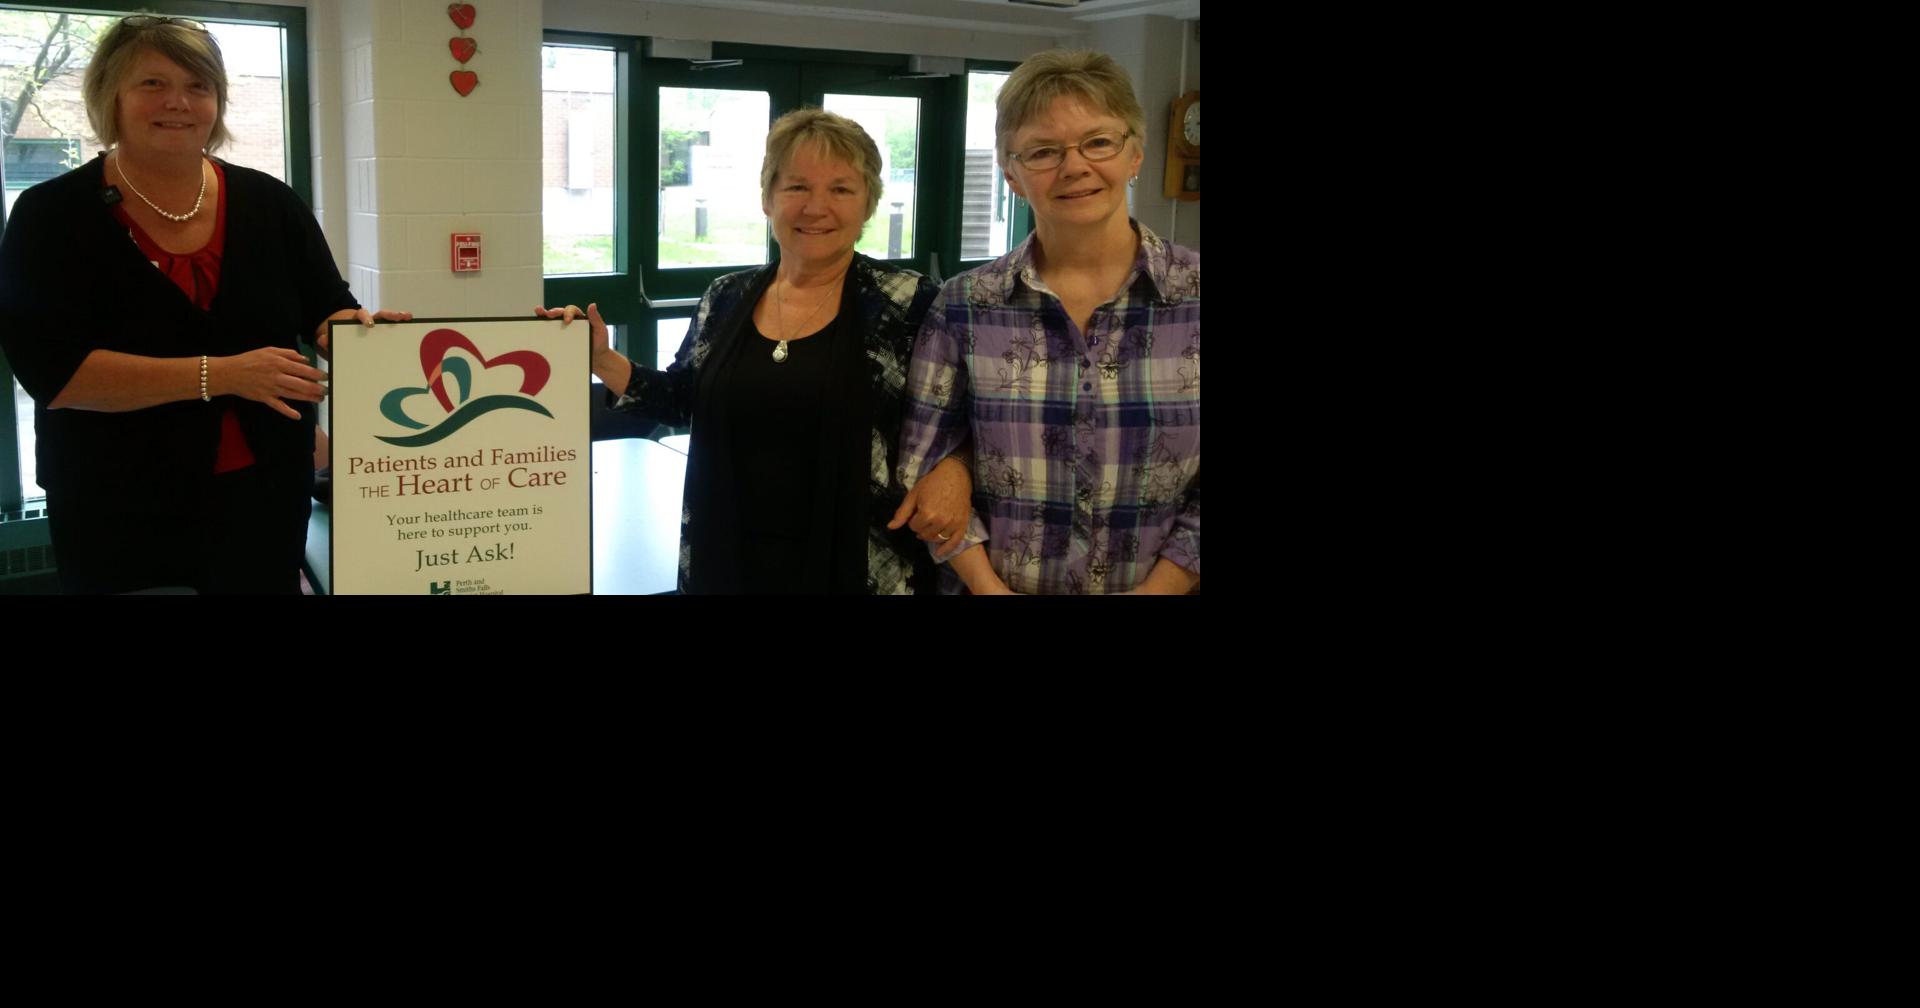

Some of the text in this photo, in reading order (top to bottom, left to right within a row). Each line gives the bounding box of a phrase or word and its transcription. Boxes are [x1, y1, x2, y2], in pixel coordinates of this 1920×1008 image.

[348, 445, 577, 475] Patients and Families
[360, 467, 567, 498] THE Heart OF Care
[387, 504, 543, 526] Your healthcare team is
[398, 522, 532, 540] here to support you.
[415, 542, 514, 572] Just Ask!
[456, 579, 472, 587] Perth
